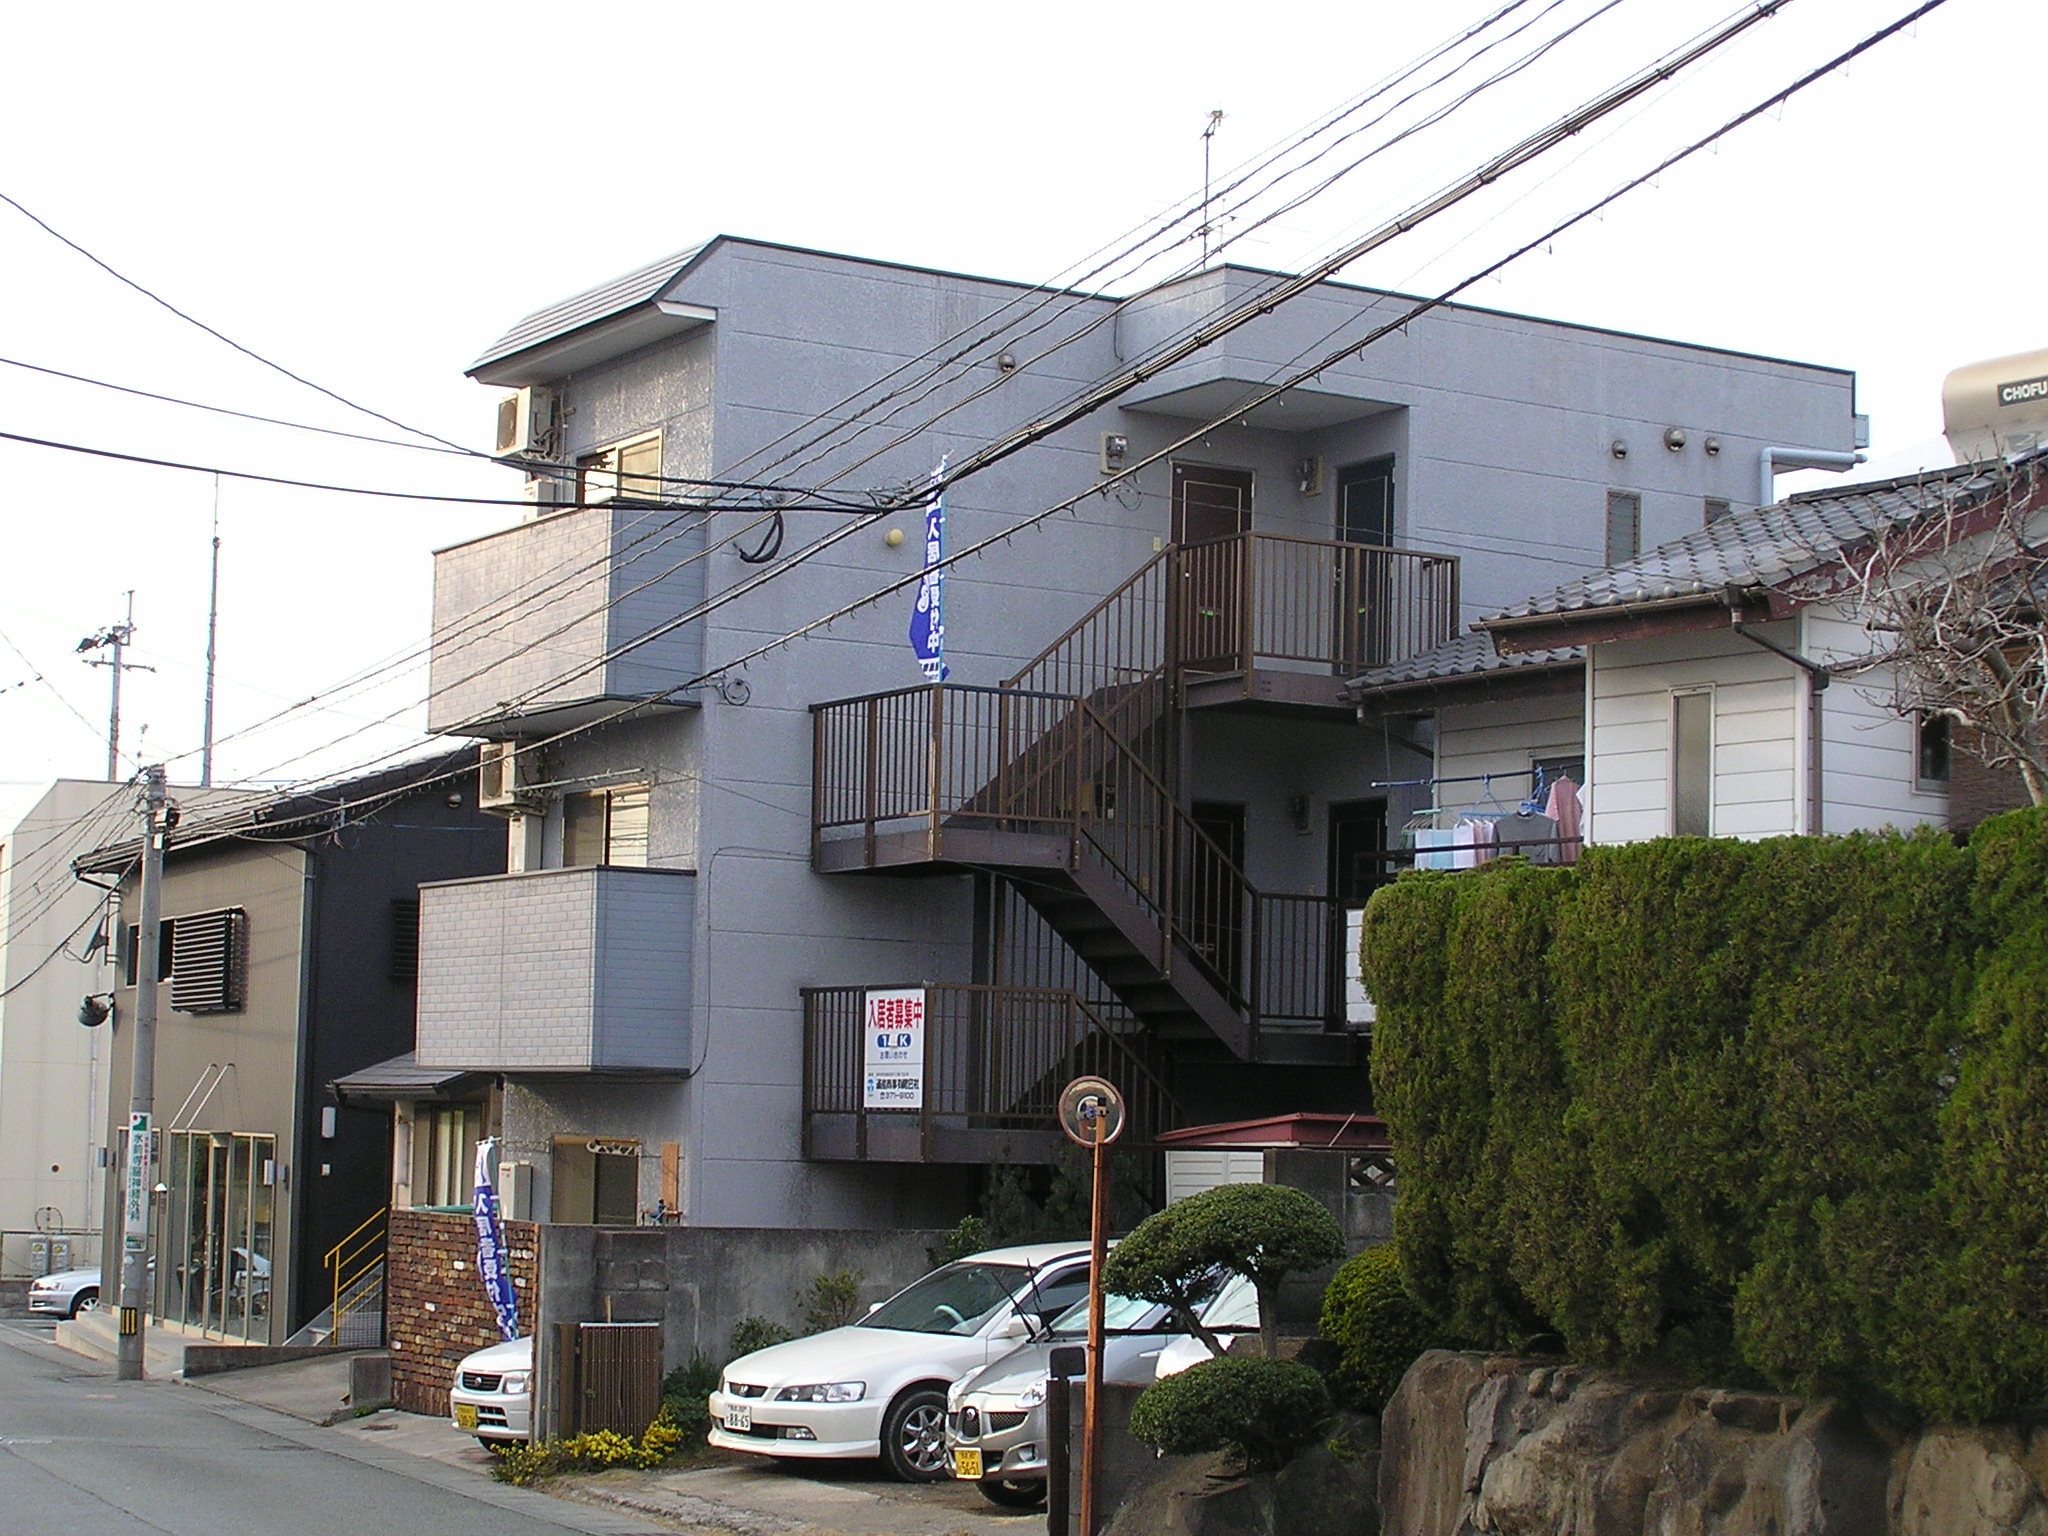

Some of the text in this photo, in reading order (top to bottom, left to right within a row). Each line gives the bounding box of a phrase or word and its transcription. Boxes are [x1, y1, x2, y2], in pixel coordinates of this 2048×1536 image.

[2002, 381, 2048, 402] CHOFU
[868, 997, 922, 1029] 入居者募集中
